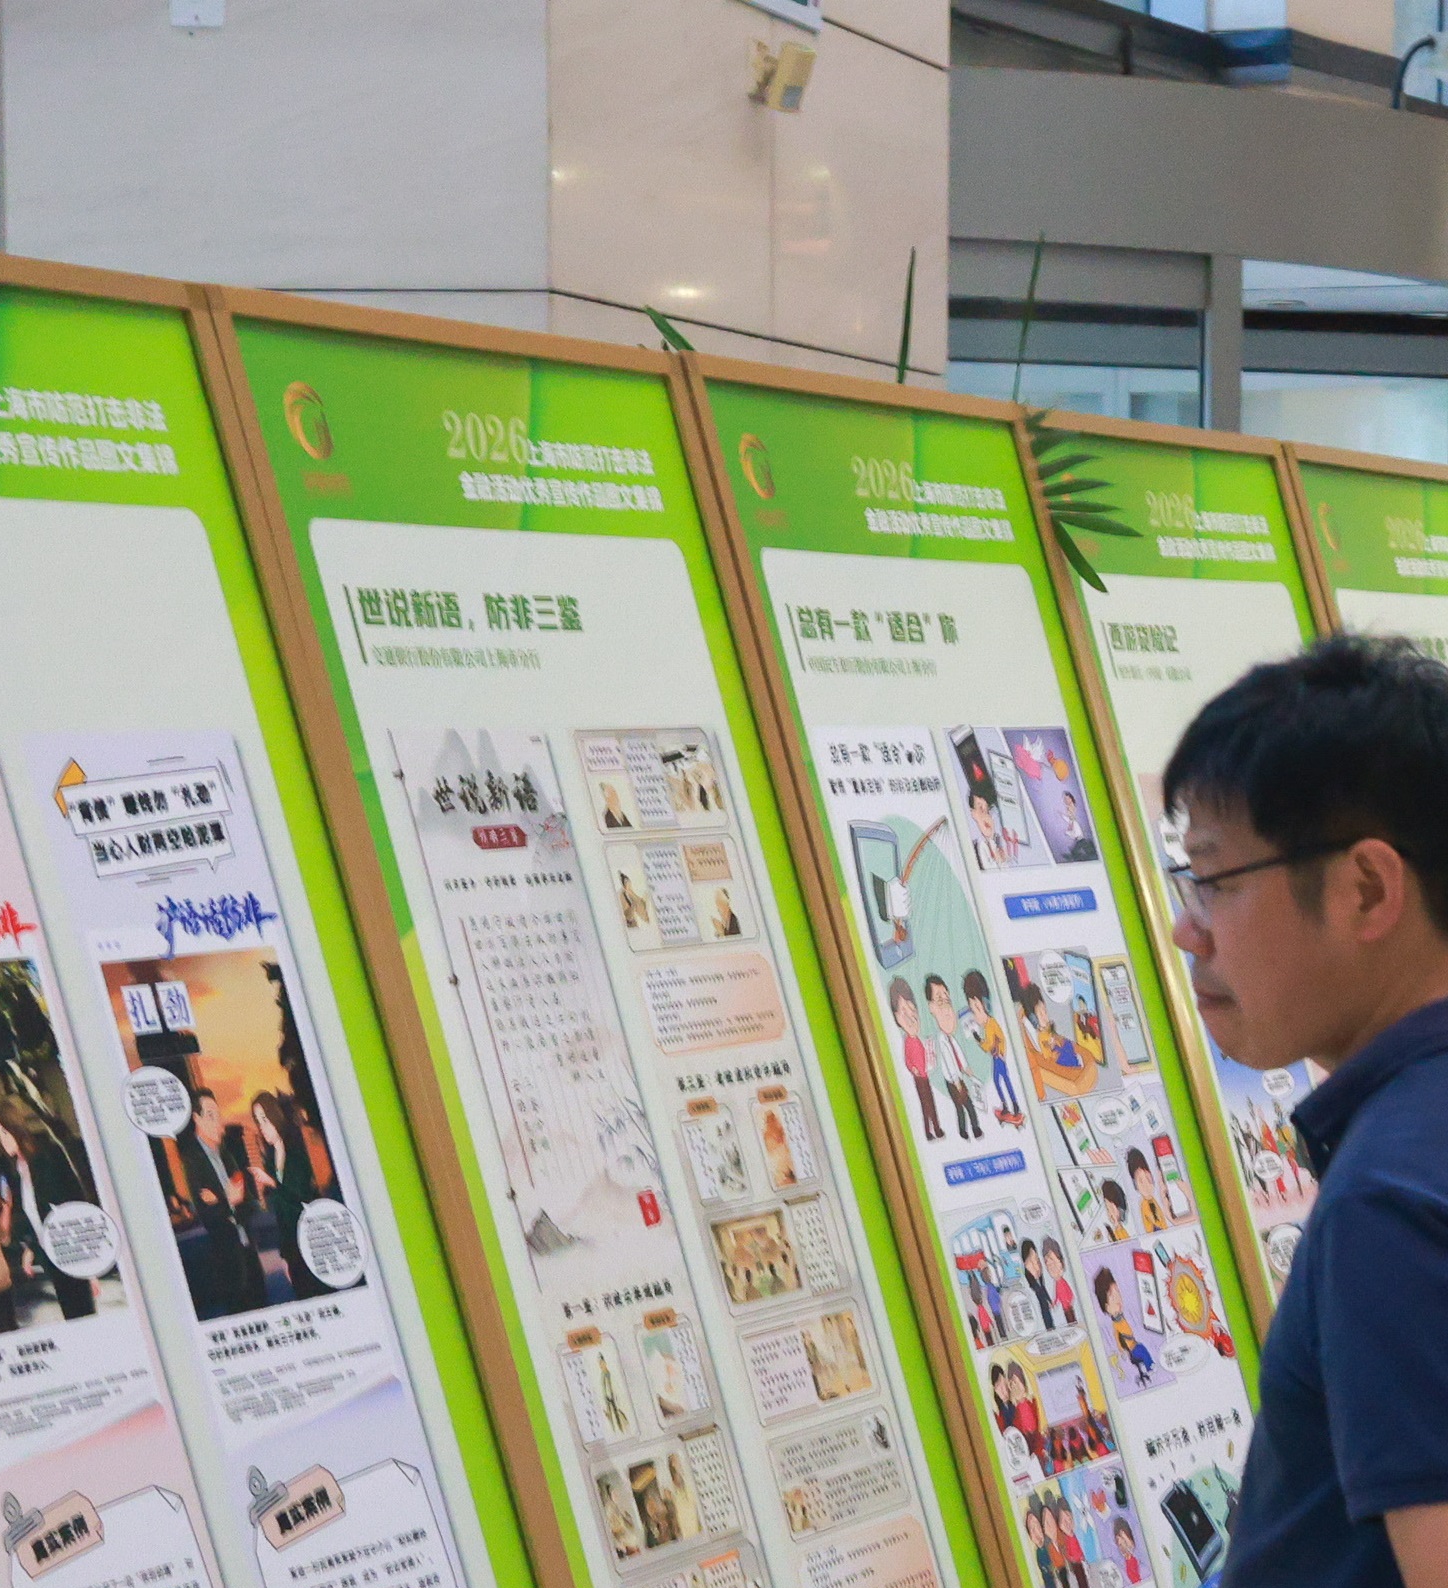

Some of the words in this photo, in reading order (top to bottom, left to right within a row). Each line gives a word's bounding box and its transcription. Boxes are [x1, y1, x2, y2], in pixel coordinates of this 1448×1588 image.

[353, 587, 586, 633] 世说新语，防非三鉴
